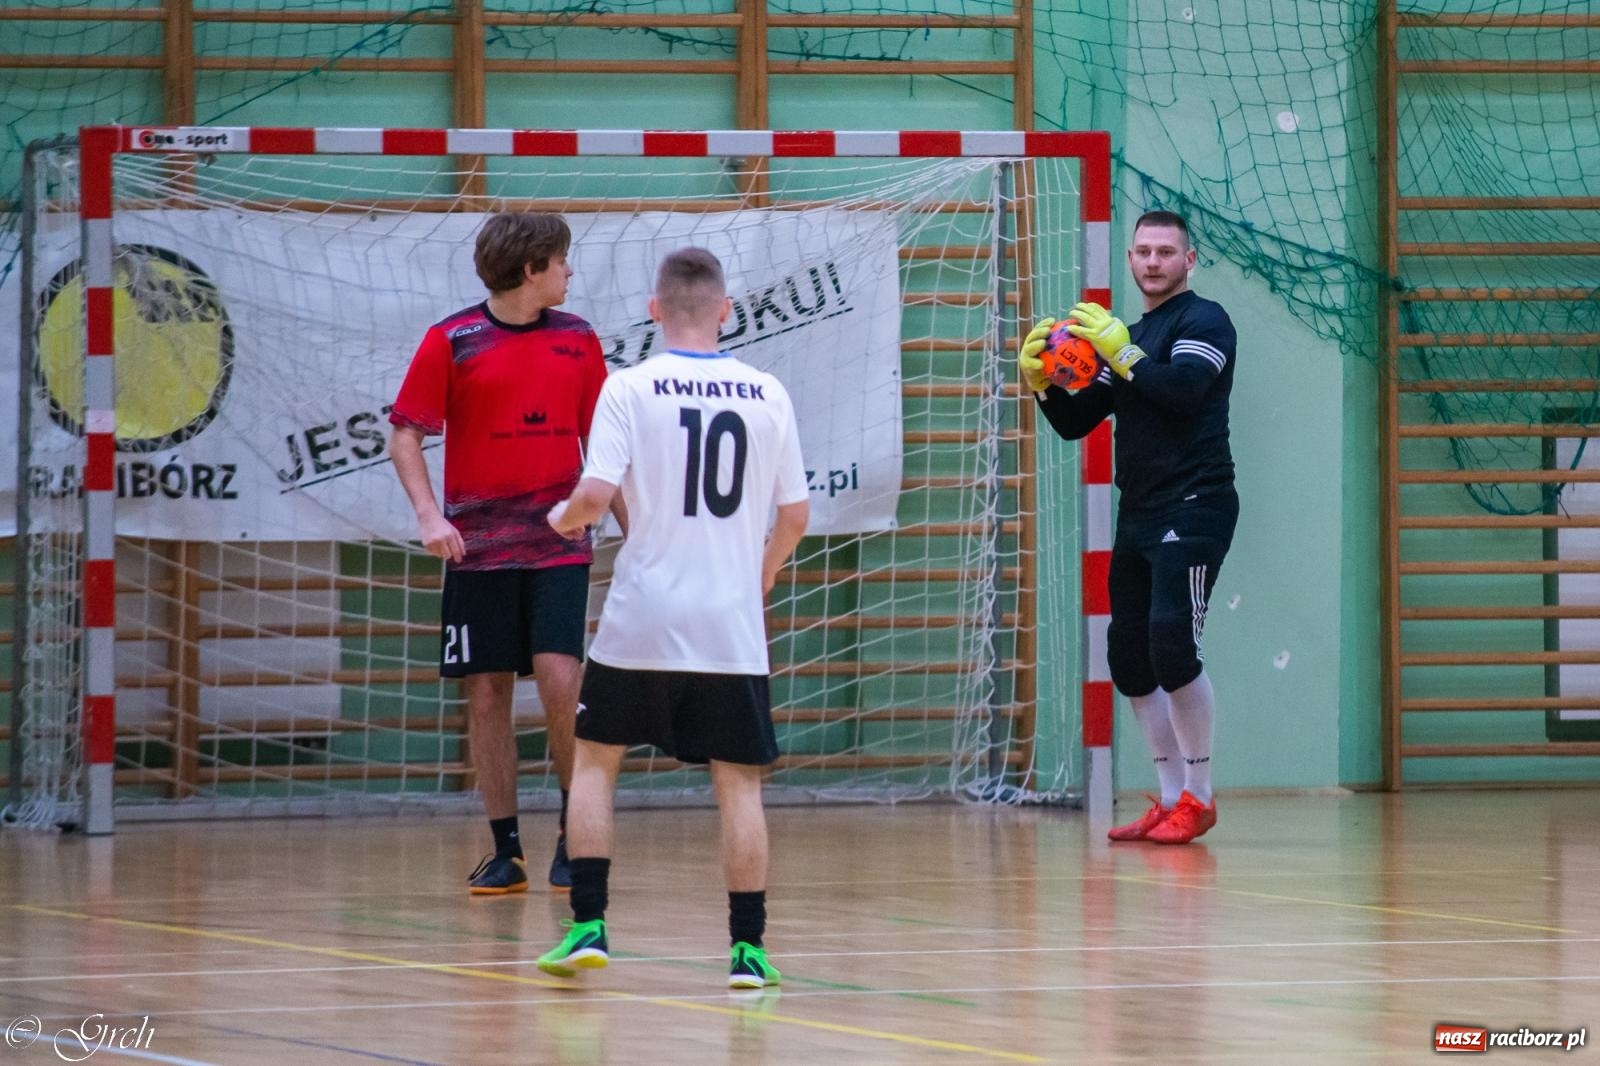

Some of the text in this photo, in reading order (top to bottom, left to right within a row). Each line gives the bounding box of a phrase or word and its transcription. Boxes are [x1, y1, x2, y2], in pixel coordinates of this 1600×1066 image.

[653, 378, 765, 401] KWIATEK
[277, 404, 393, 483] JES
[679, 407, 748, 518] 10
[29, 454, 239, 500] RAIBÓRZ
[444, 624, 470, 664] 21
